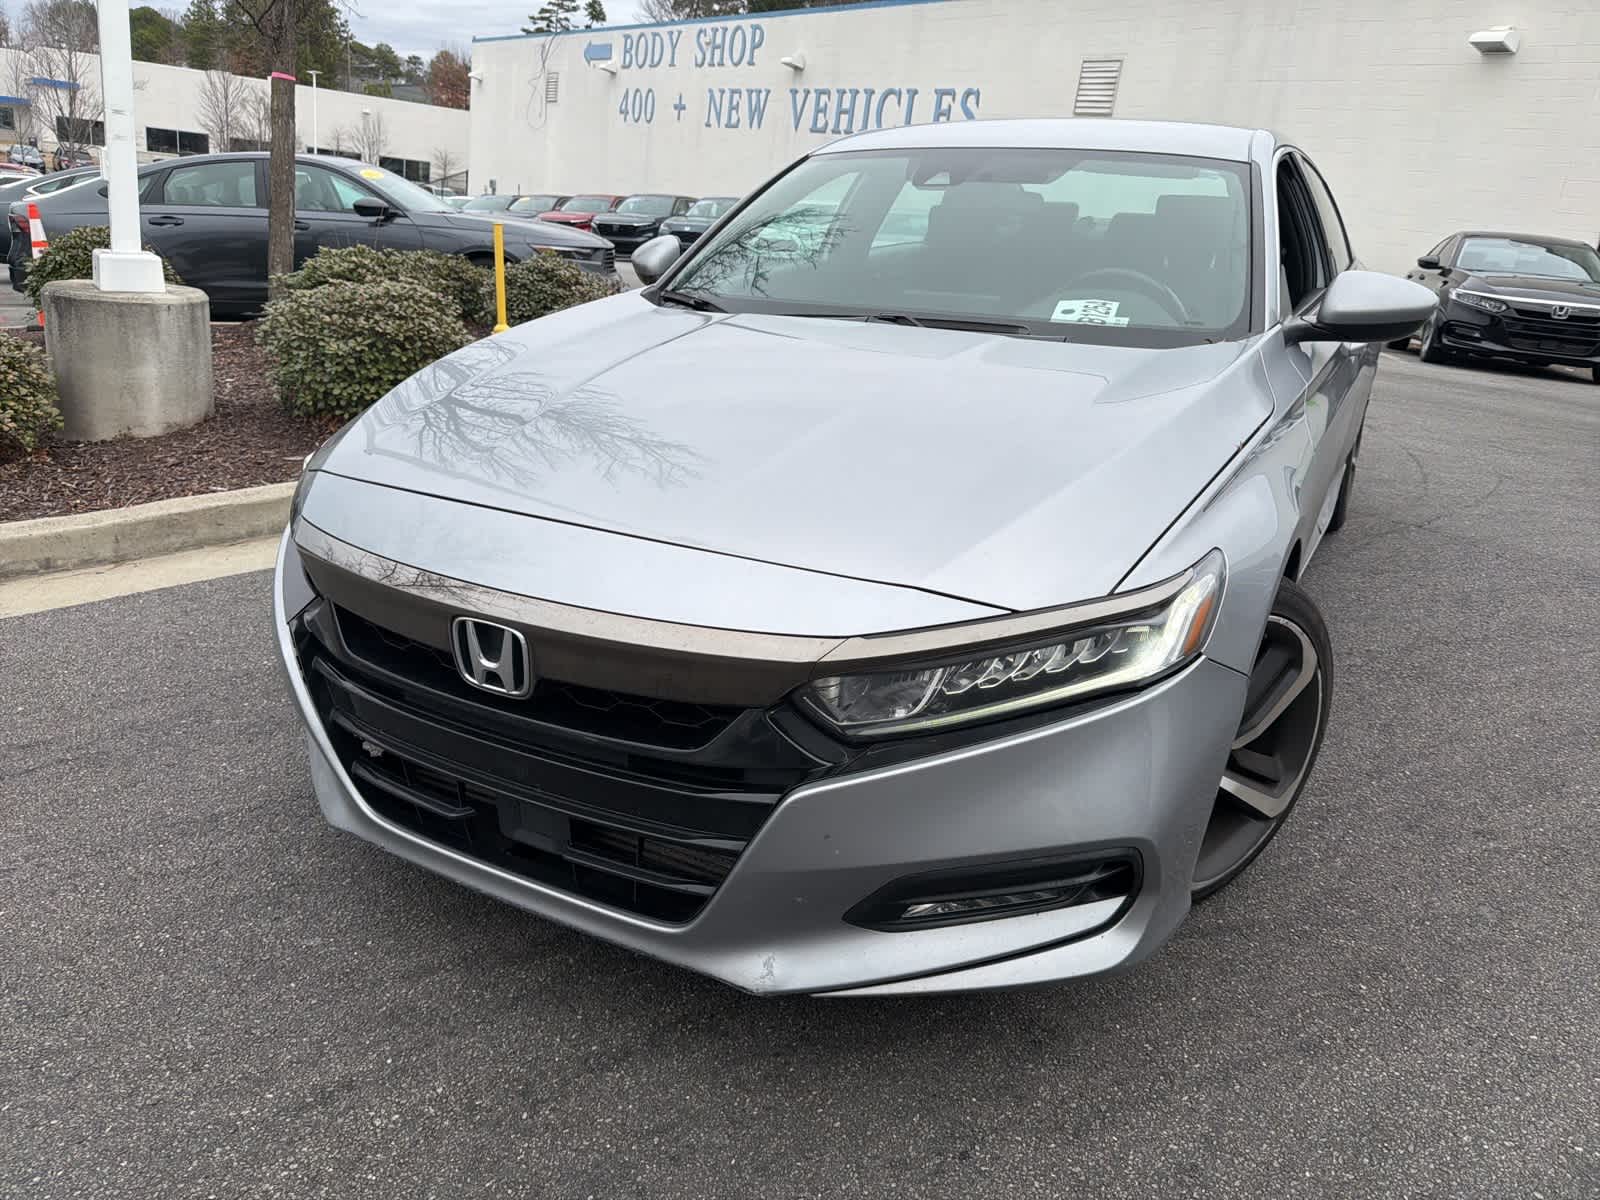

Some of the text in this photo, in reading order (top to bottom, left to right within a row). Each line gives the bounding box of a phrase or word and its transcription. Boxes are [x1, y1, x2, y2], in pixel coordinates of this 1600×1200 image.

[621, 23, 765, 69] BODY SHOP
[618, 88, 656, 123] 400
[705, 88, 771, 129] NEW
[789, 87, 981, 134] VEHICLES
